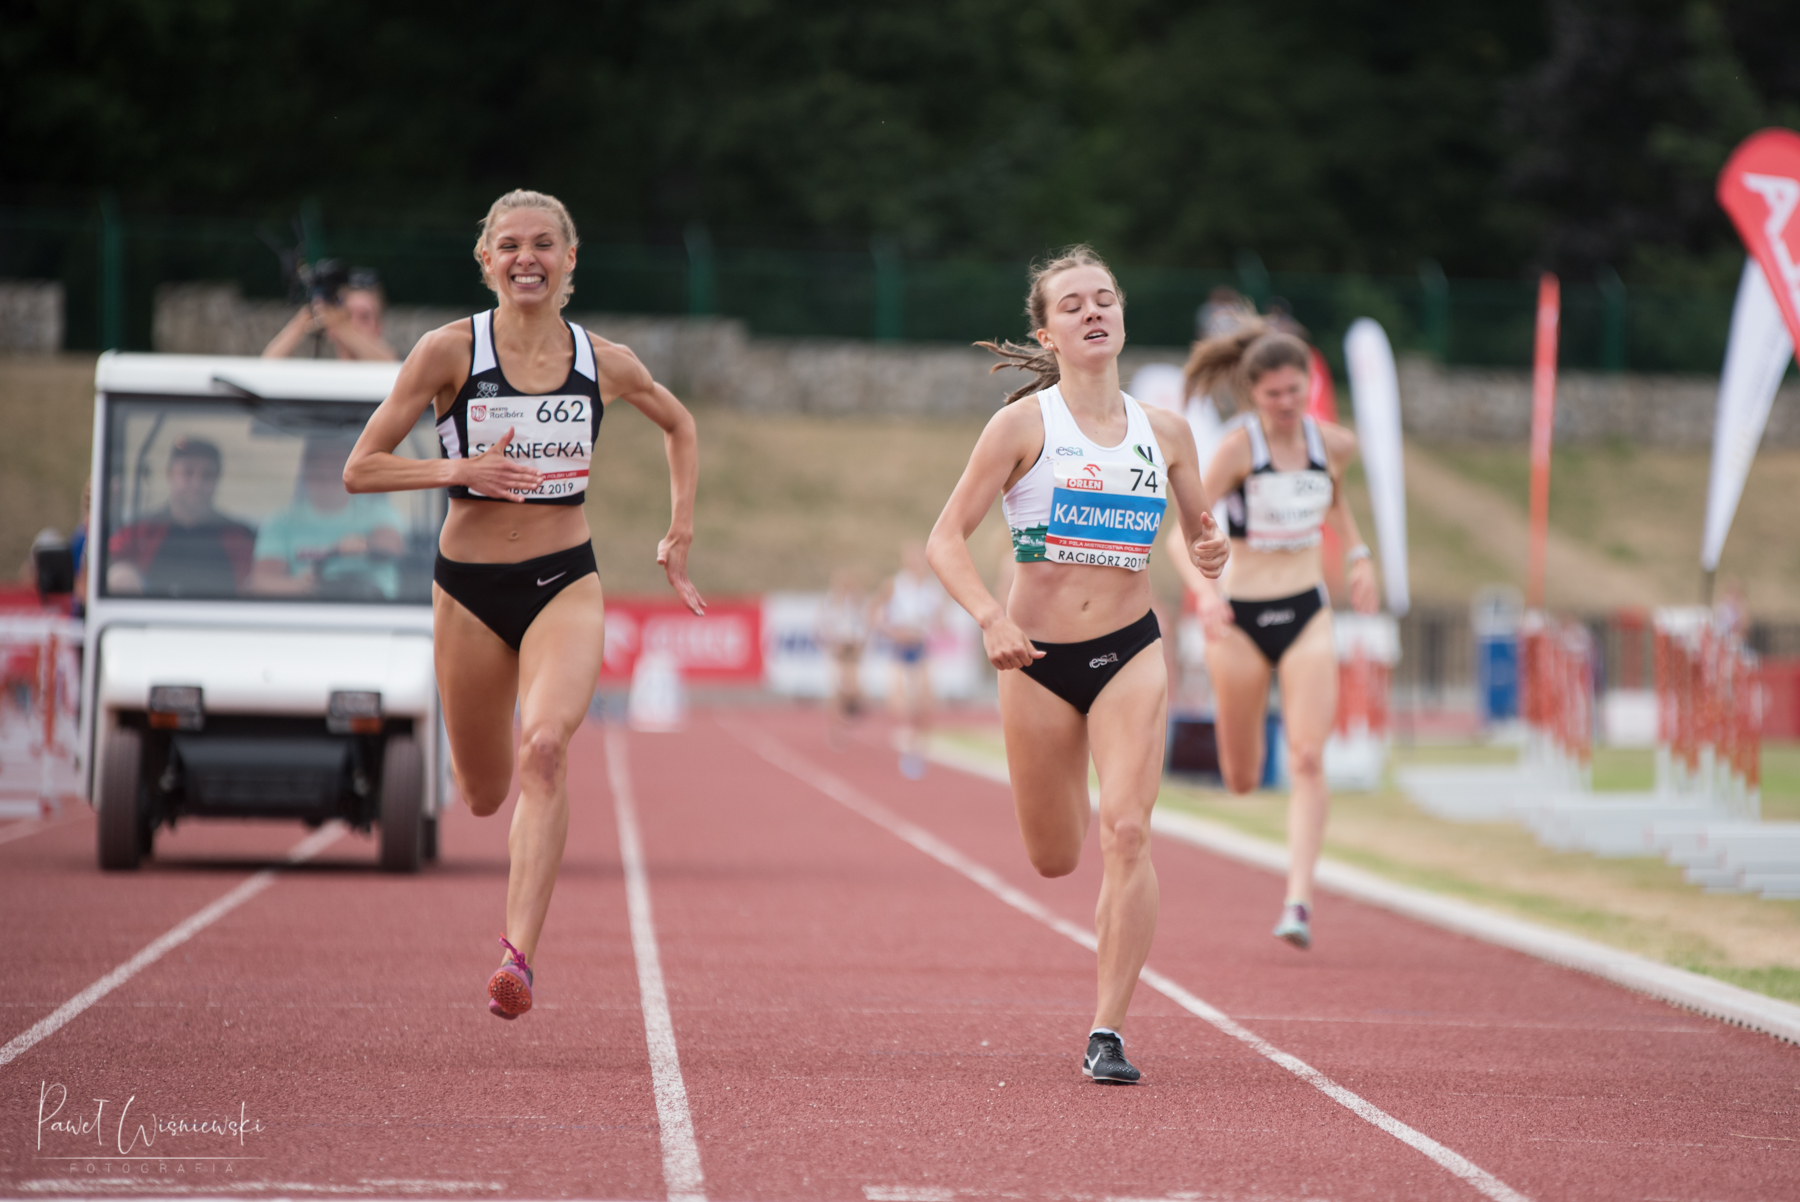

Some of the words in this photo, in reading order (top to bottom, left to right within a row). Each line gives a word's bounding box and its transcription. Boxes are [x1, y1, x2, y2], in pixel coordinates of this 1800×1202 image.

[536, 400, 585, 423] 662
[1056, 446, 1084, 456] esa
[549, 482, 574, 495] 2019
[1068, 479, 1102, 490] ORLEN
[1130, 468, 1158, 493] 74
[1054, 503, 1160, 531] KAZIMIERSKA
[1058, 550, 1121, 567] RACIBÓRZ
[1088, 652, 1118, 669] esa
